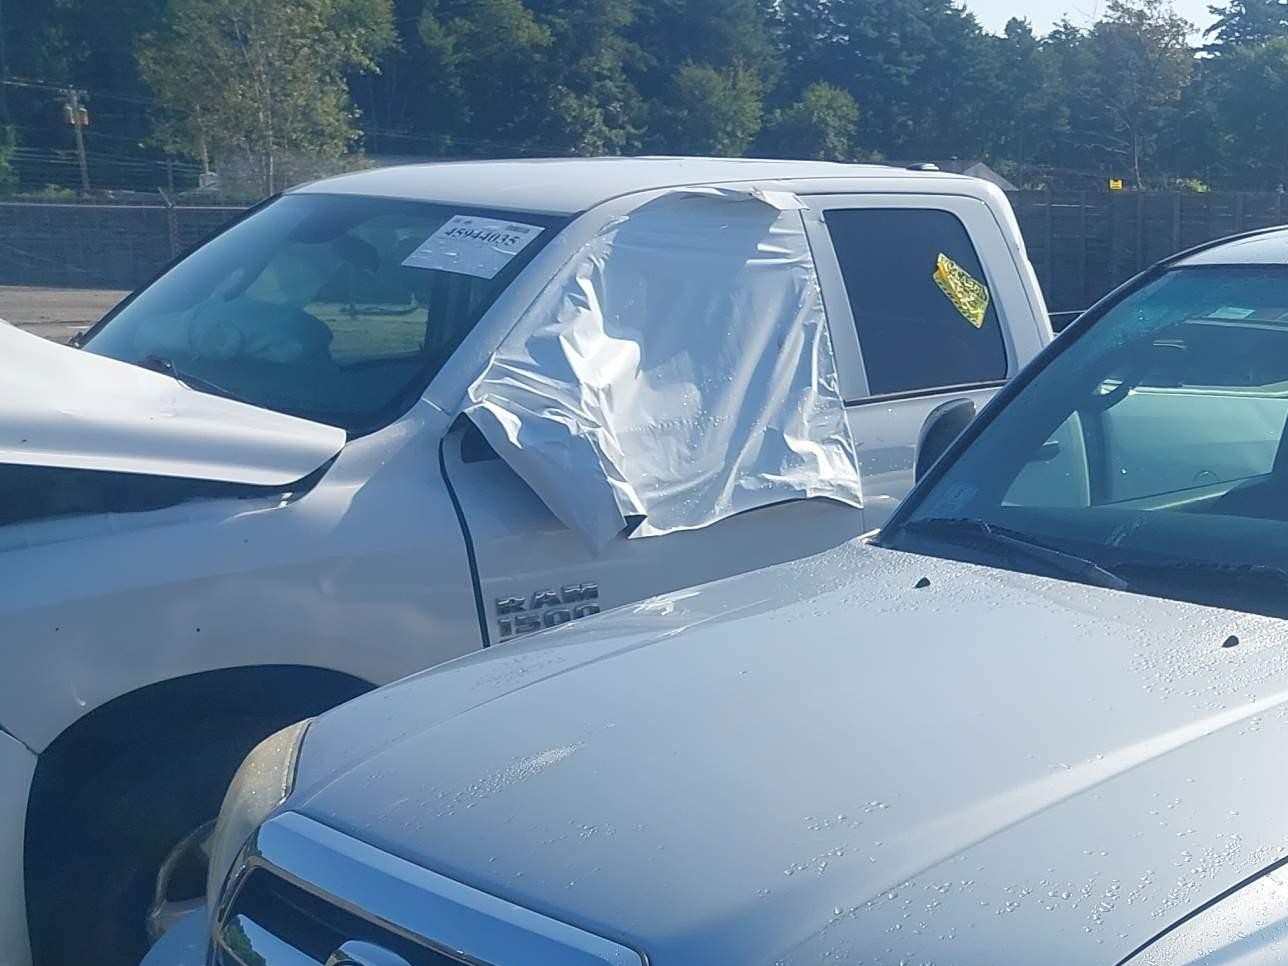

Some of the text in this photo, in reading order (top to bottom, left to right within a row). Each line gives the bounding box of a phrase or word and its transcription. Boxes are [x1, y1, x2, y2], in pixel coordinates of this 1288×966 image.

[444, 227, 521, 247] 45944035
[495, 582, 600, 616] RAM
[497, 602, 601, 638] 1500
